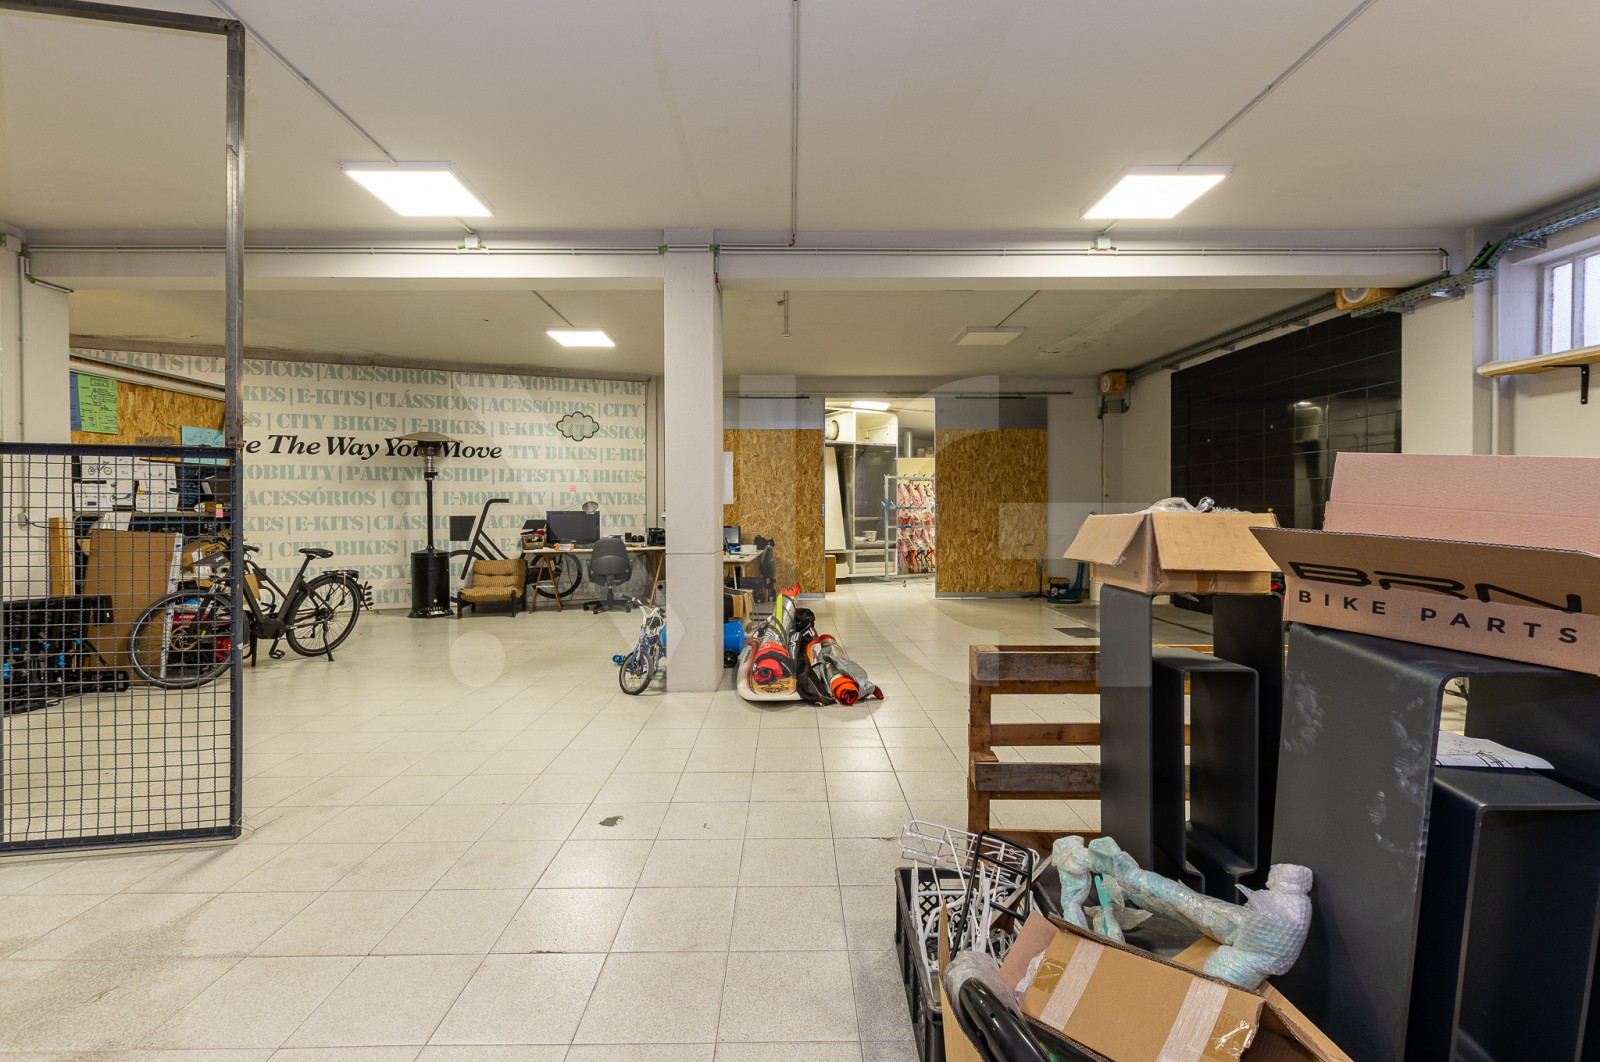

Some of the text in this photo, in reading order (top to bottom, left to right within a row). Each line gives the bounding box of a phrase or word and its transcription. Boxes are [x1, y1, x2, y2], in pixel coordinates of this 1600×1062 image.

[297, 388, 366, 406] E-KITS
[375, 390, 478, 411] CLÁSSICOS
[488, 397, 596, 416] ACESSÓRIOS
[603, 403, 640, 417] CITY
[276, 413, 327, 429] CITY
[333, 415, 397, 432] BIKES
[411, 418, 486, 435] E-BIKES
[499, 421, 556, 436] E-KITS
[268, 434, 320, 454] The
[326, 436, 379, 460] Way
[545, 446, 597, 460] BIKES
[499, 468, 588, 483] LIFESTYLE
[593, 469, 643, 483] BIKES
[245, 487, 376, 506] ACESSÓRIOS
[295, 516, 363, 531] E-KITS
[602, 514, 638, 527] CITY
[335, 541, 398, 556] BIKES
[1288, 561, 1583, 614] BRN
[1298, 590, 1579, 645] BIKE PARTS
